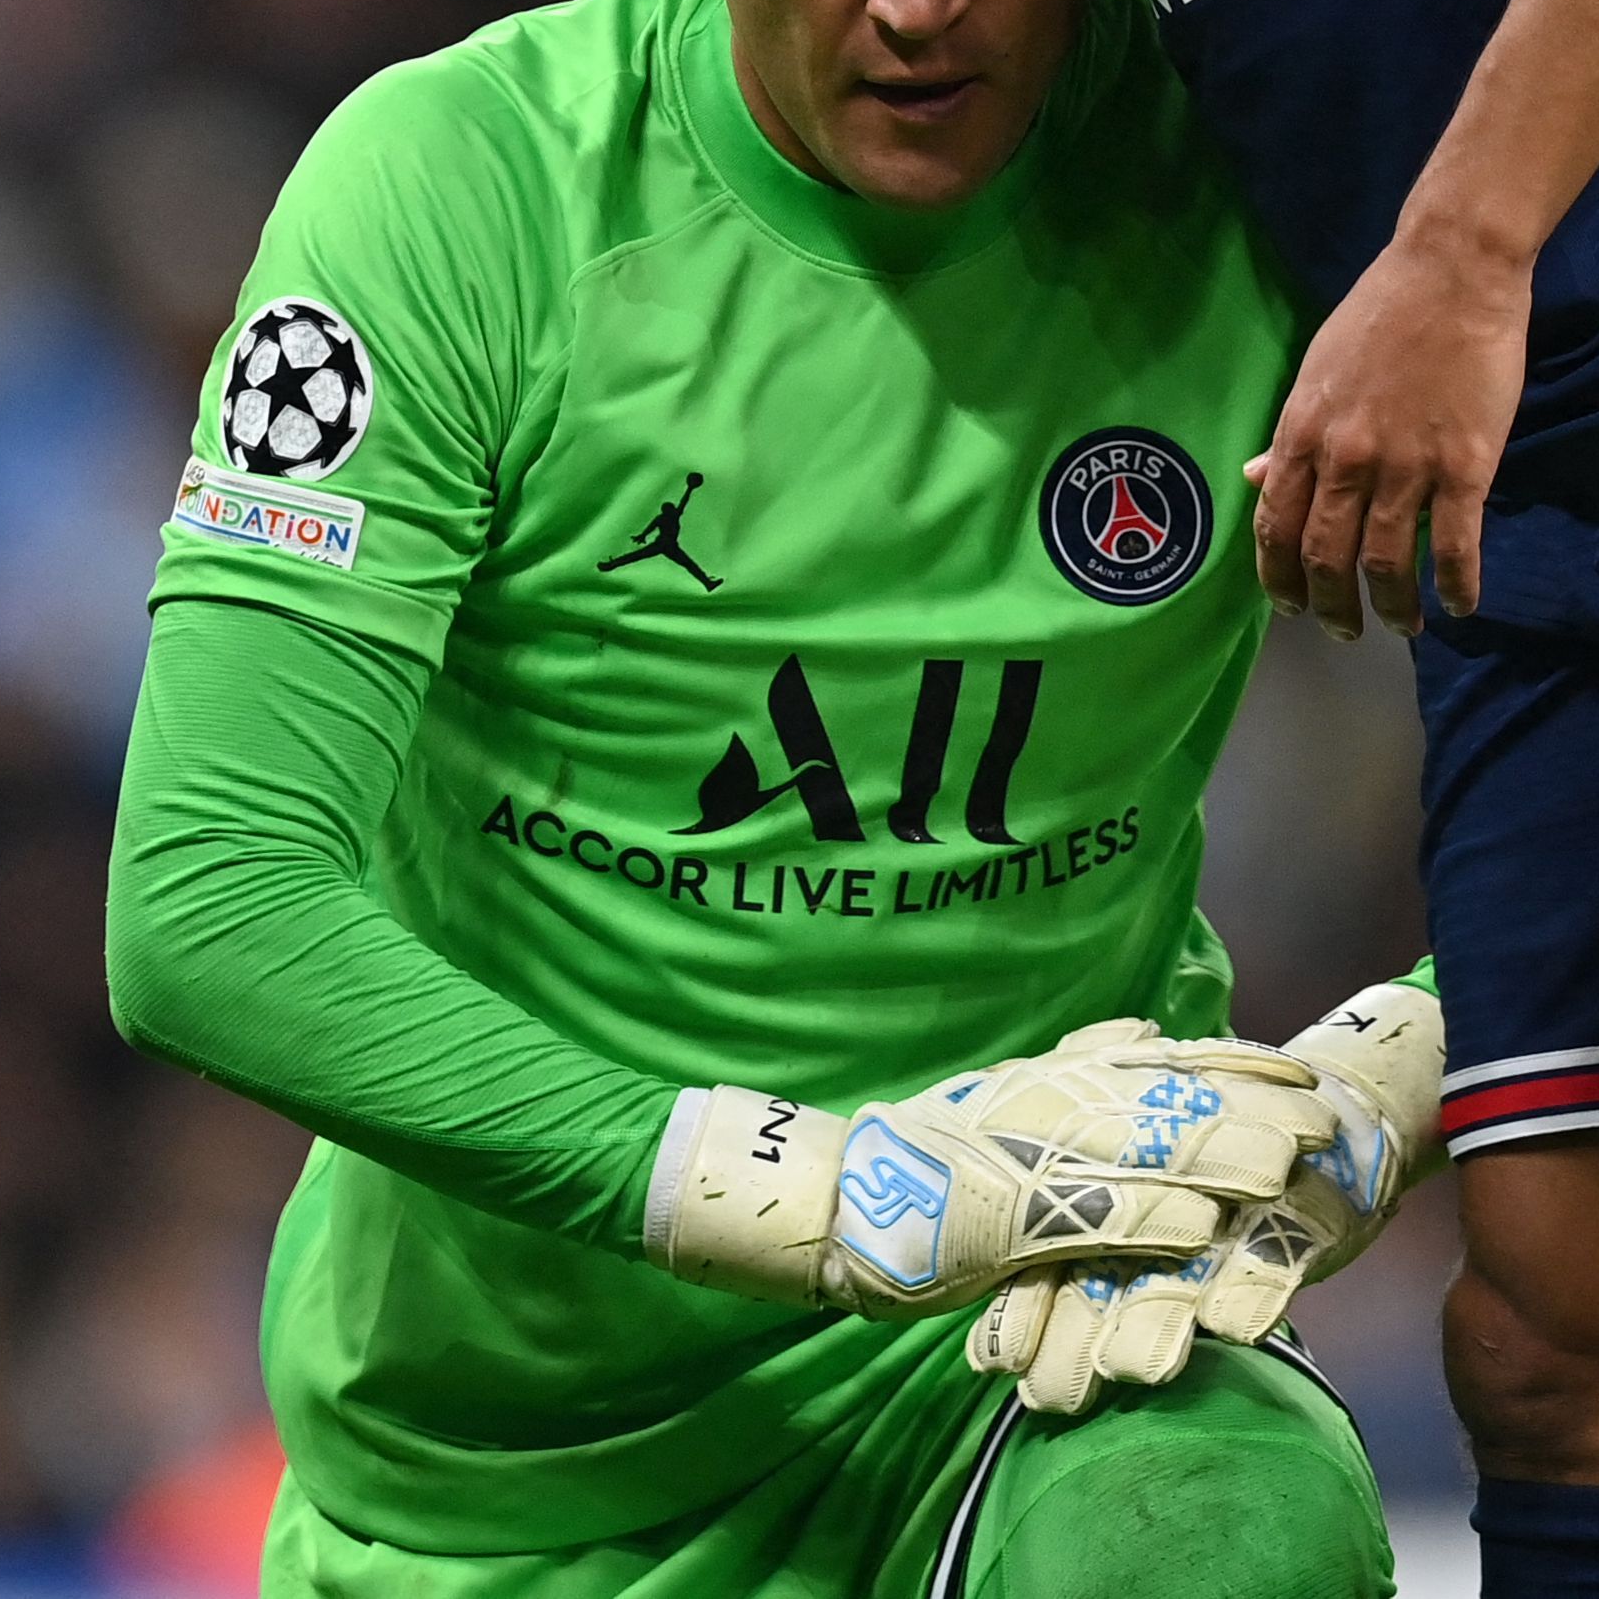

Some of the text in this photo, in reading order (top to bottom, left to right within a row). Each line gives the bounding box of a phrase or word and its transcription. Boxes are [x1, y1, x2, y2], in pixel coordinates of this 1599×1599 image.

[1069, 447, 1166, 492] PARIS
[479, 794, 1140, 917] ACCOR LIVE LIMITLESS
